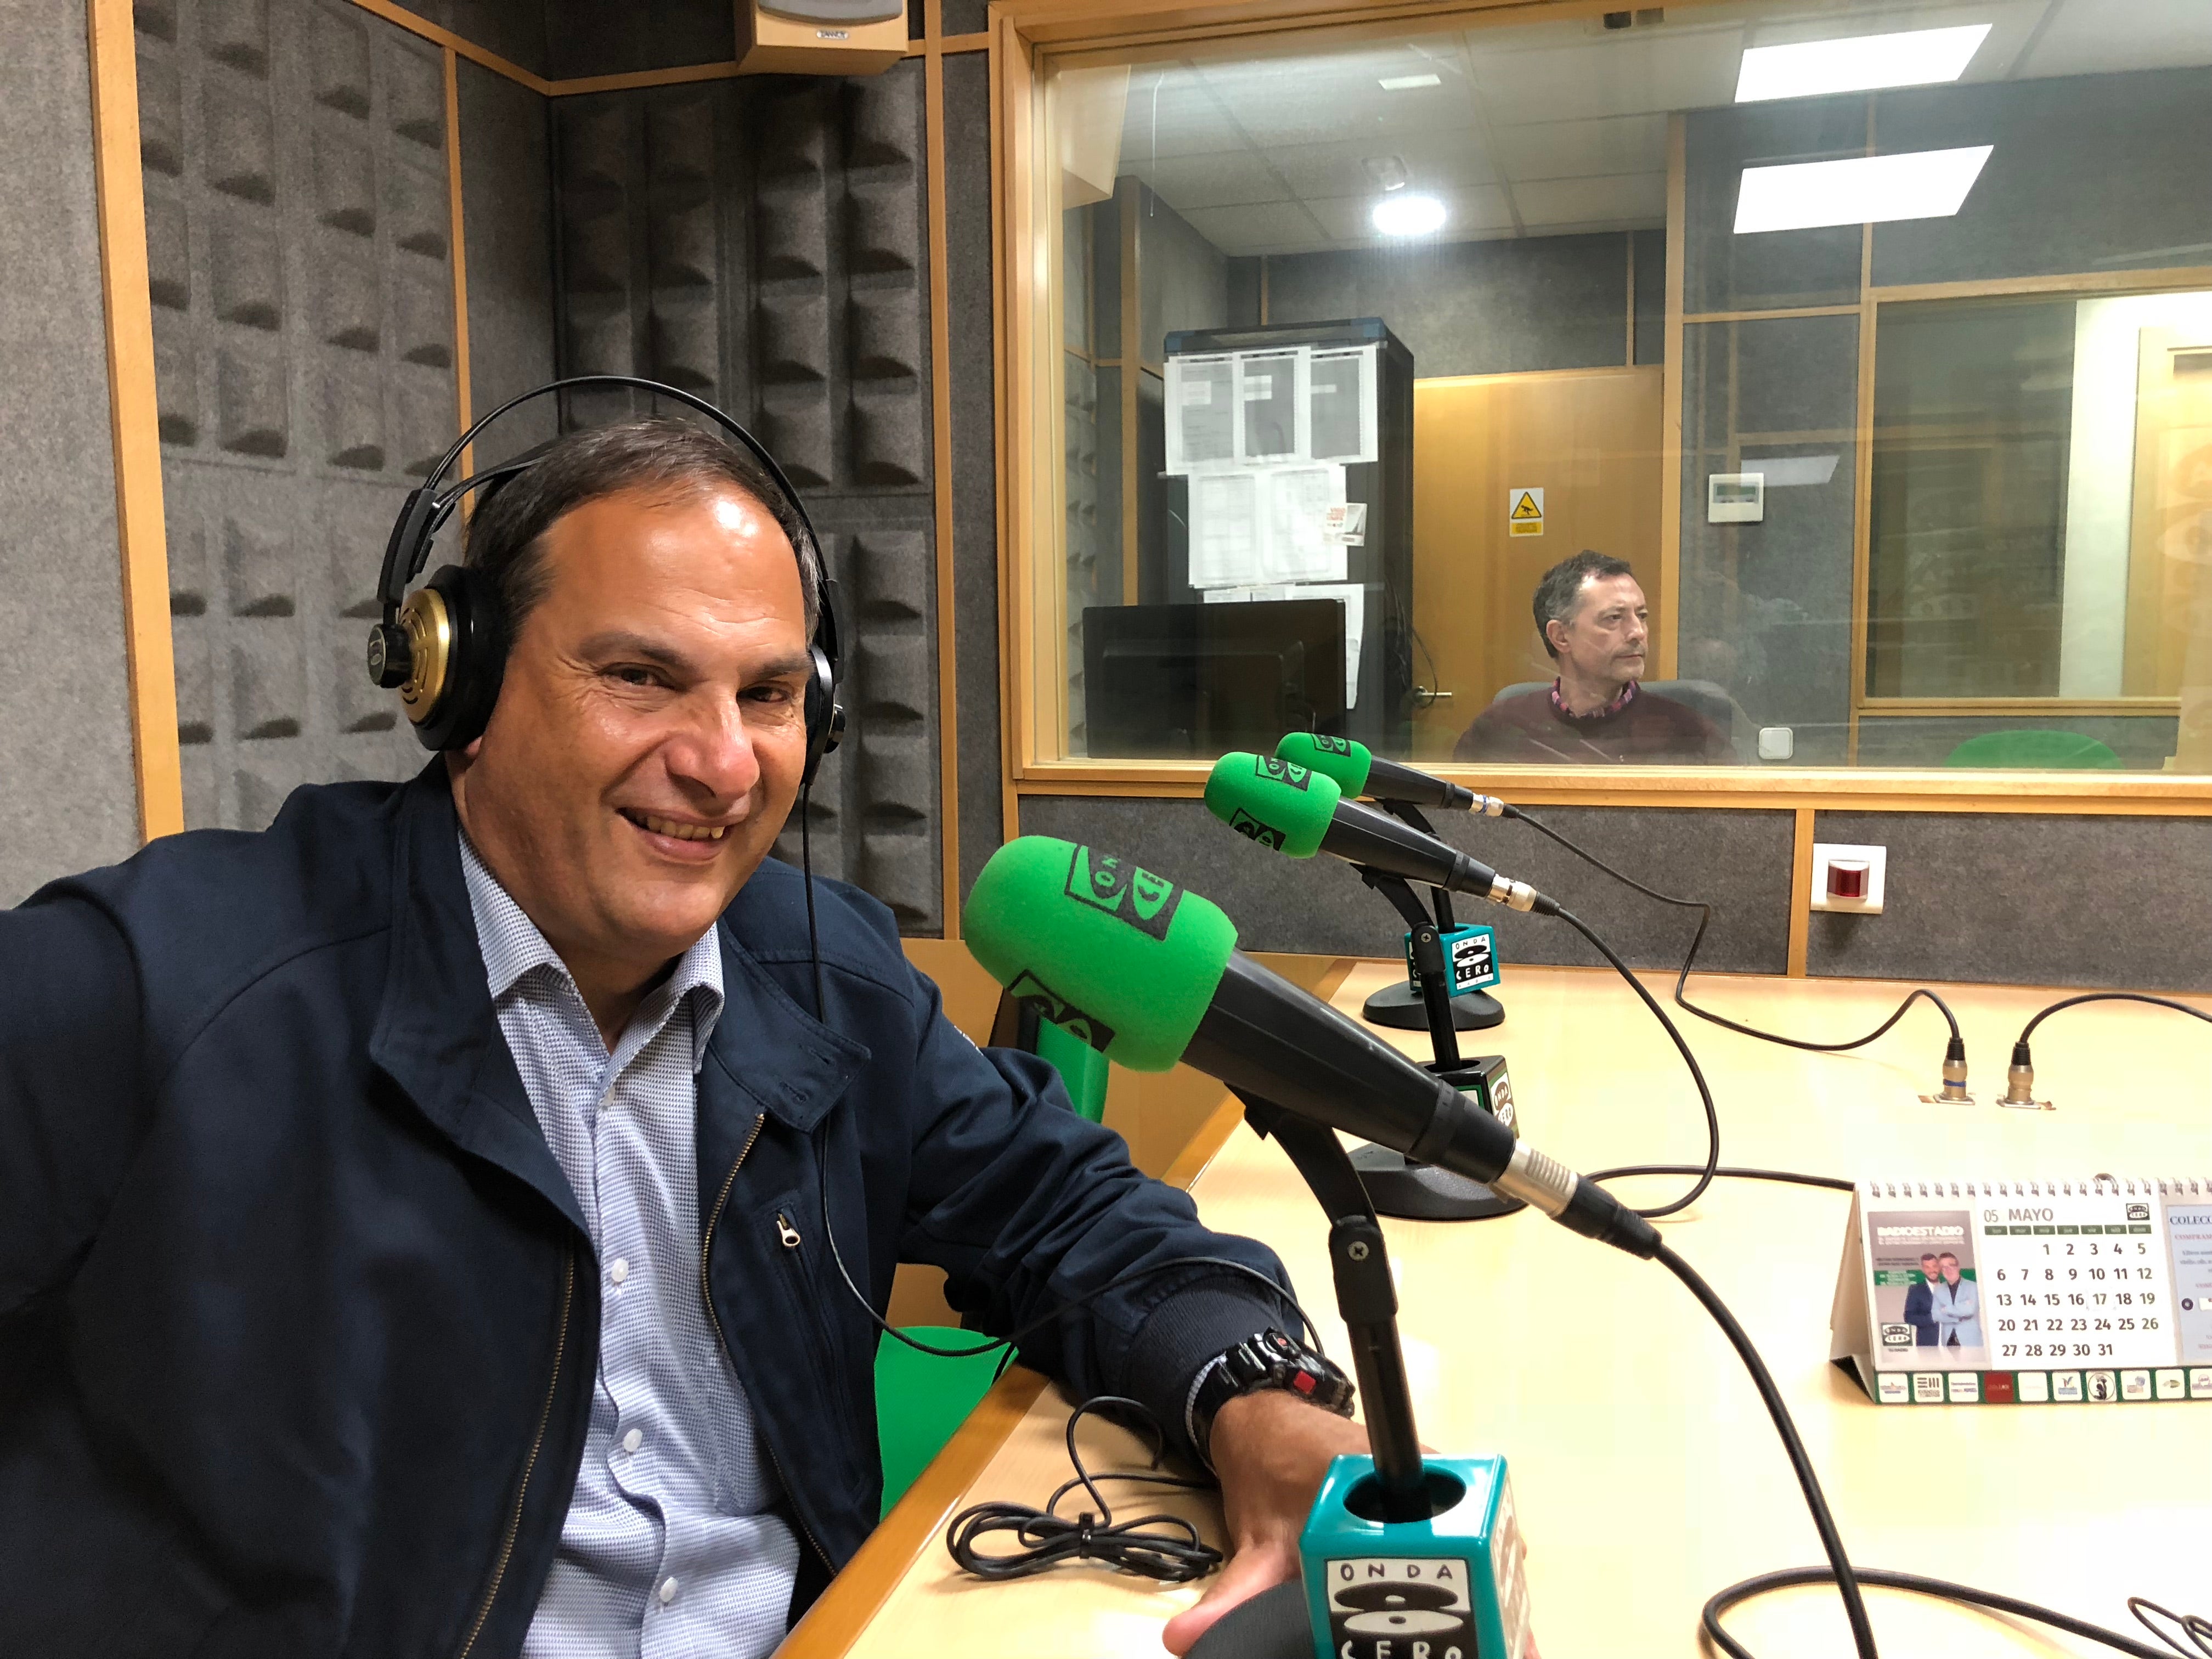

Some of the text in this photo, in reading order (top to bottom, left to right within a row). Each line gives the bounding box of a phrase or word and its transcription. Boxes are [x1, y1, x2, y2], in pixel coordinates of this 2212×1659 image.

[1455, 936, 1486, 950] ONDA
[1455, 964, 1489, 980] CERO
[1494, 1085, 1508, 1107] ONDA
[1984, 1208, 2053, 1223] 05 MAYO
[1877, 1226, 1964, 1236] RADIOESTADIO
[2042, 1243, 2146, 1255] 1 2 3 4 5
[1997, 1267, 2153, 1281] 6 7 8 9 10 11 12
[1996, 1292, 2155, 1306] 13 14 15 16 17 18 19
[1997, 1317, 2159, 1331] 20 21 22 23 24 25 26
[2002, 1344, 2113, 1357] 27 28 29 30 31
[1340, 1562, 1453, 1582] ONDA
